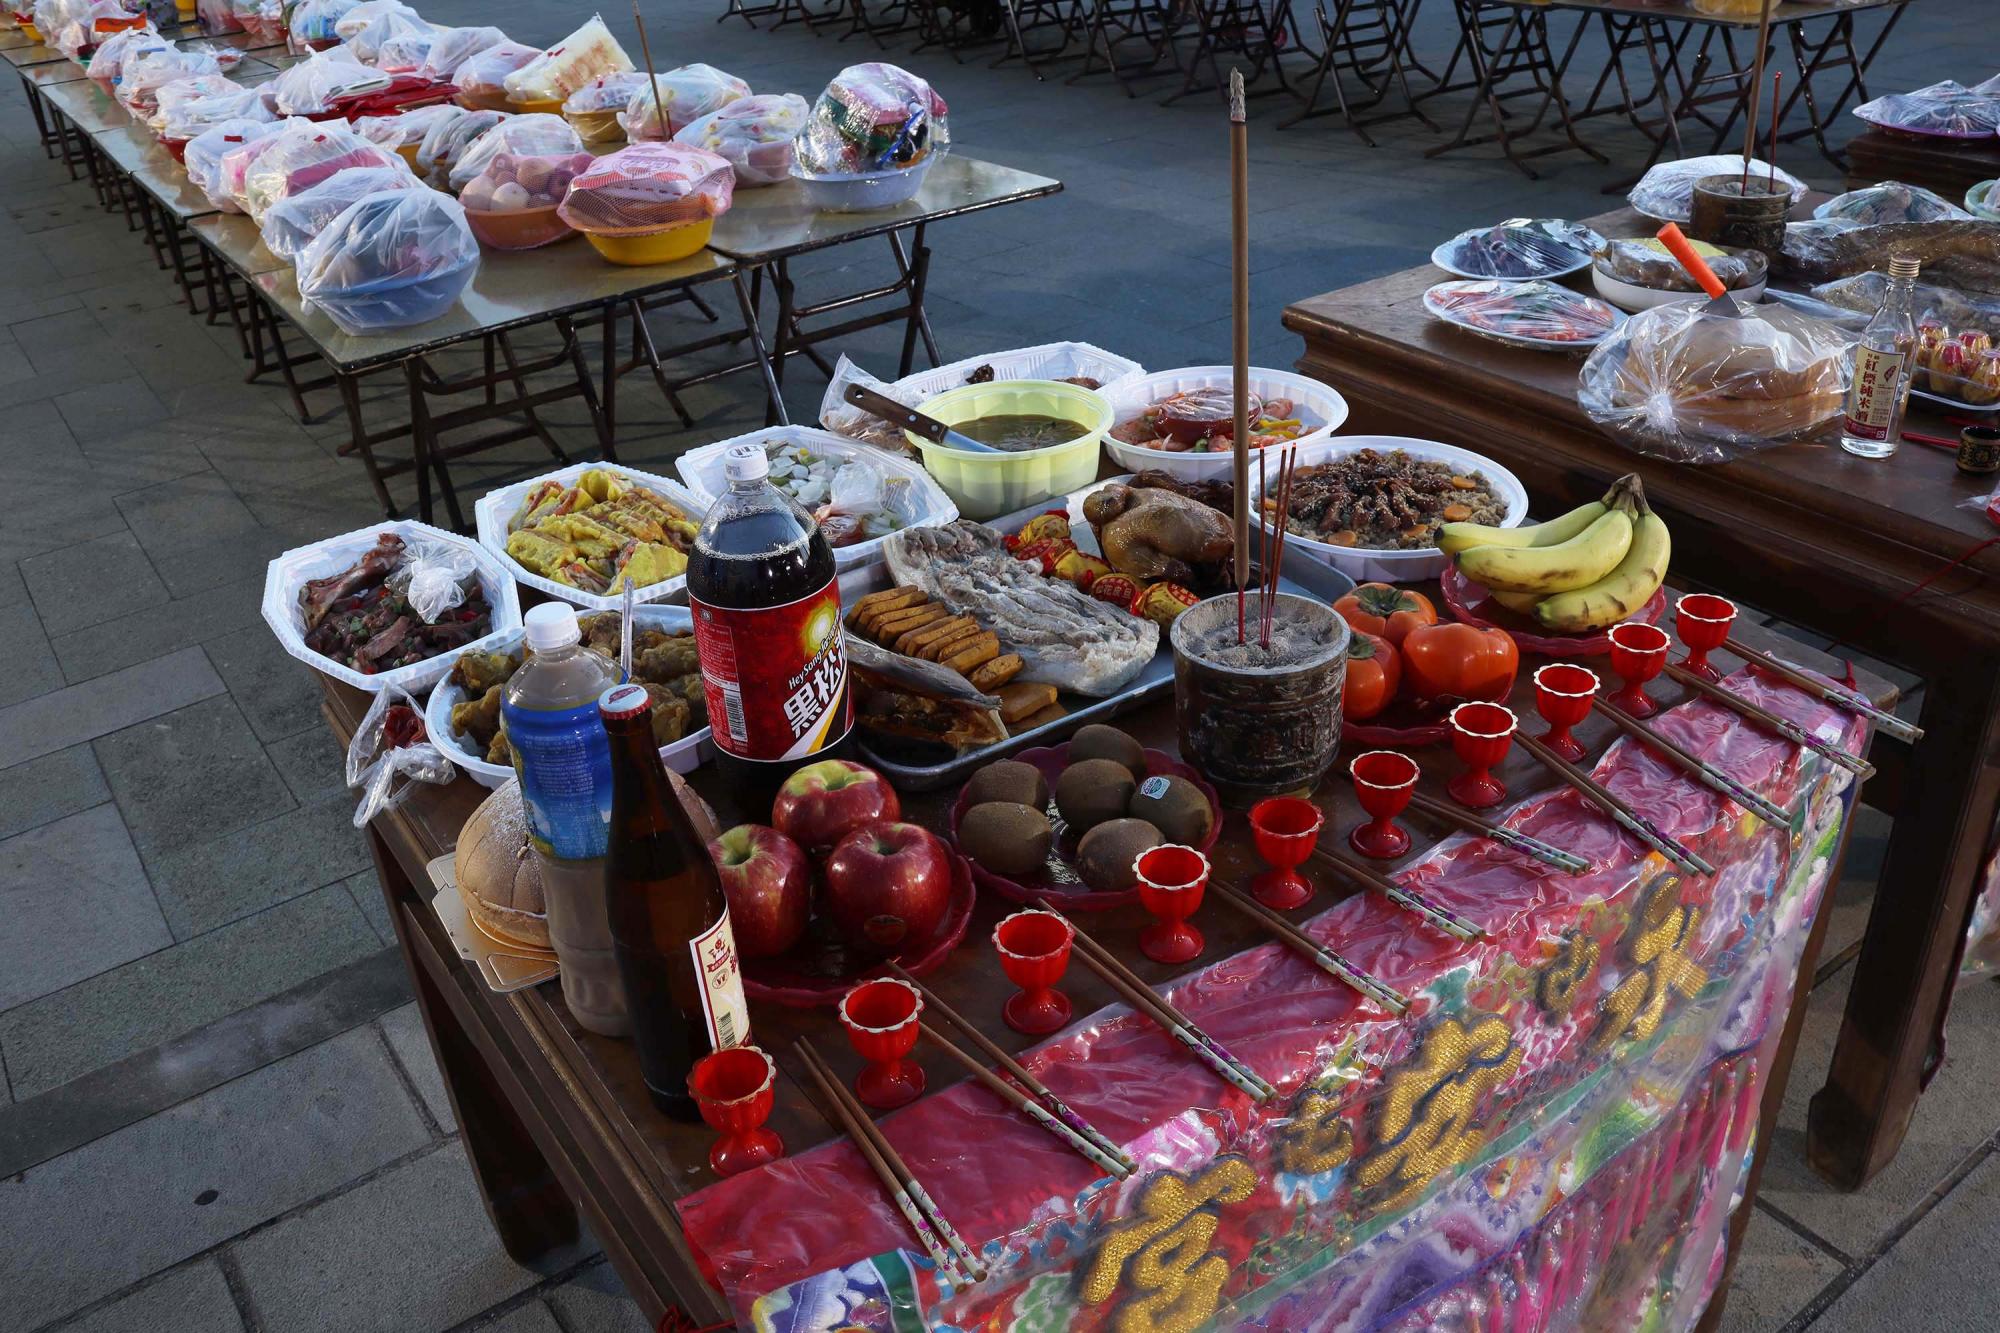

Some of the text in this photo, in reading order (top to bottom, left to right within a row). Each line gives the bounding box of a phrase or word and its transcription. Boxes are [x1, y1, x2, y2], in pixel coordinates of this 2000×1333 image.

[1855, 358, 1879, 422] 紅標純米酒
